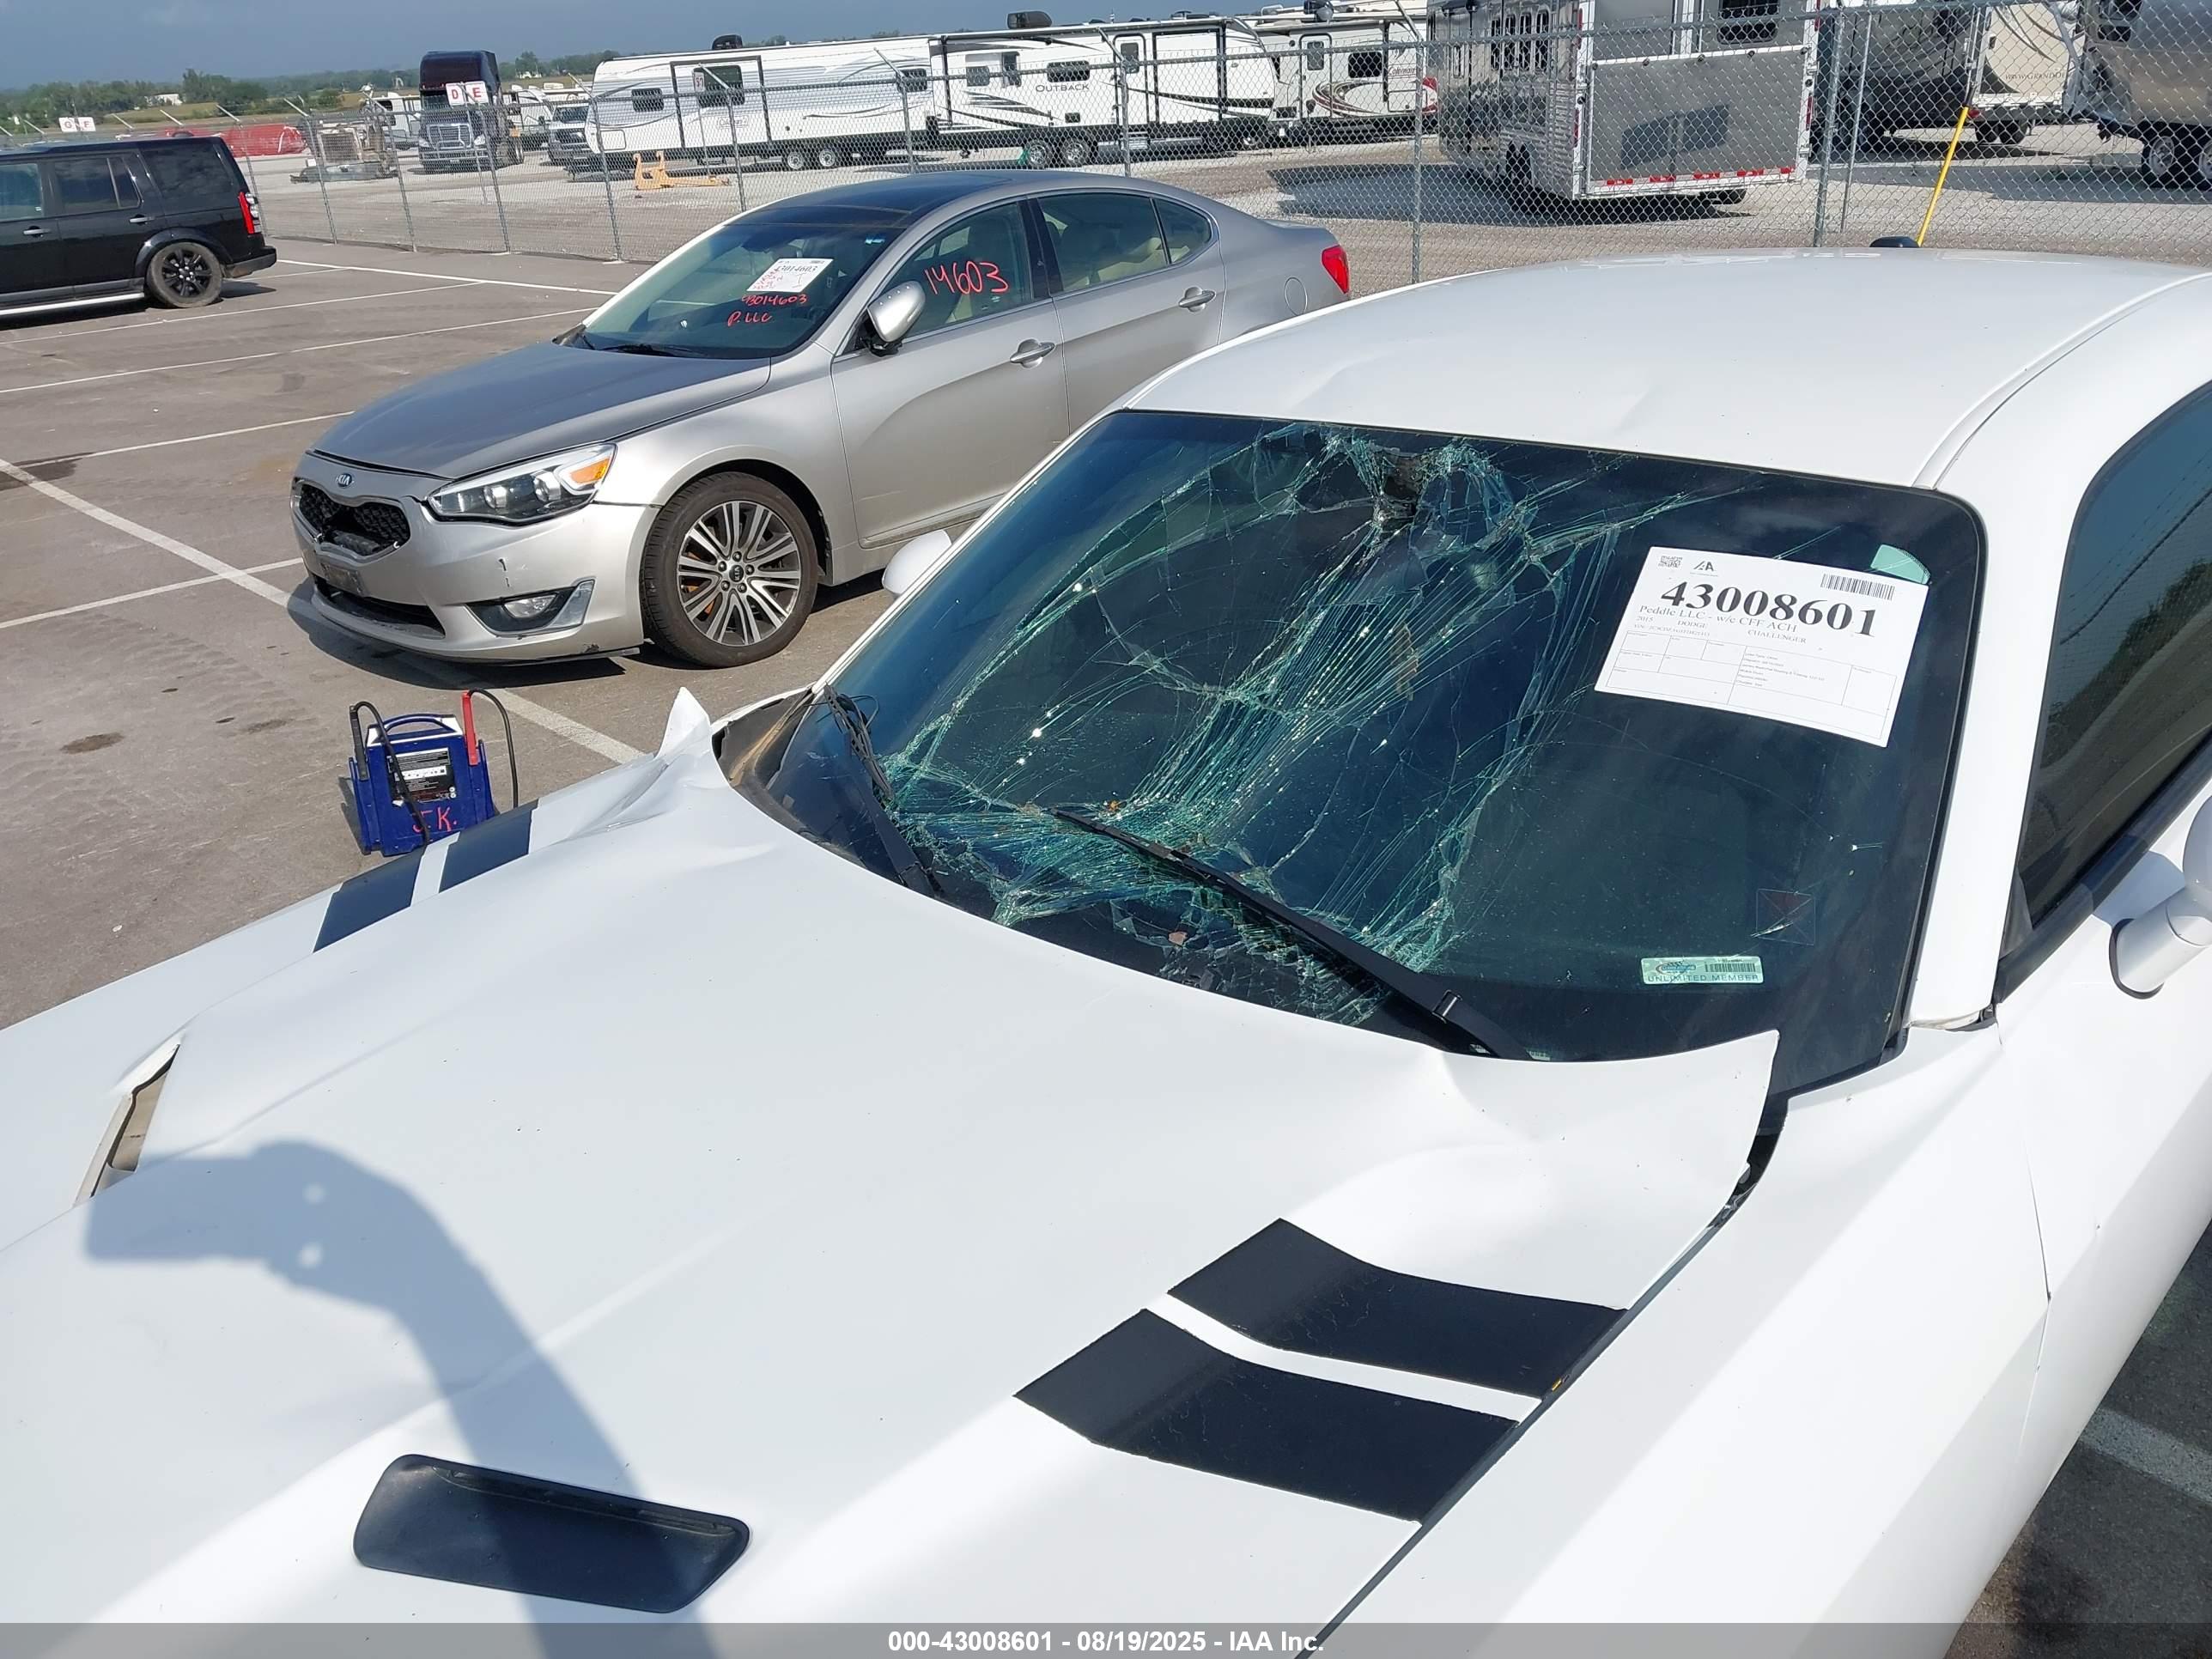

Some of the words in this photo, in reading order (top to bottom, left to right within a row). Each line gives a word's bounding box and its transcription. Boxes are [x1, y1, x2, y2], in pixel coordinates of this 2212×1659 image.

[451, 88, 459, 100] D
[472, 87, 482, 98] E
[1035, 83, 1090, 93] OUTBACK
[924, 260, 1009, 295] 14603
[338, 474, 350, 486] KIA
[1661, 580, 1876, 637] 43008601
[1639, 605, 1676, 617] Peddle
[1679, 610, 1706, 619] LLC
[1766, 622, 1797, 633] ACH
[1747, 629, 1807, 644] CHALLENGER
